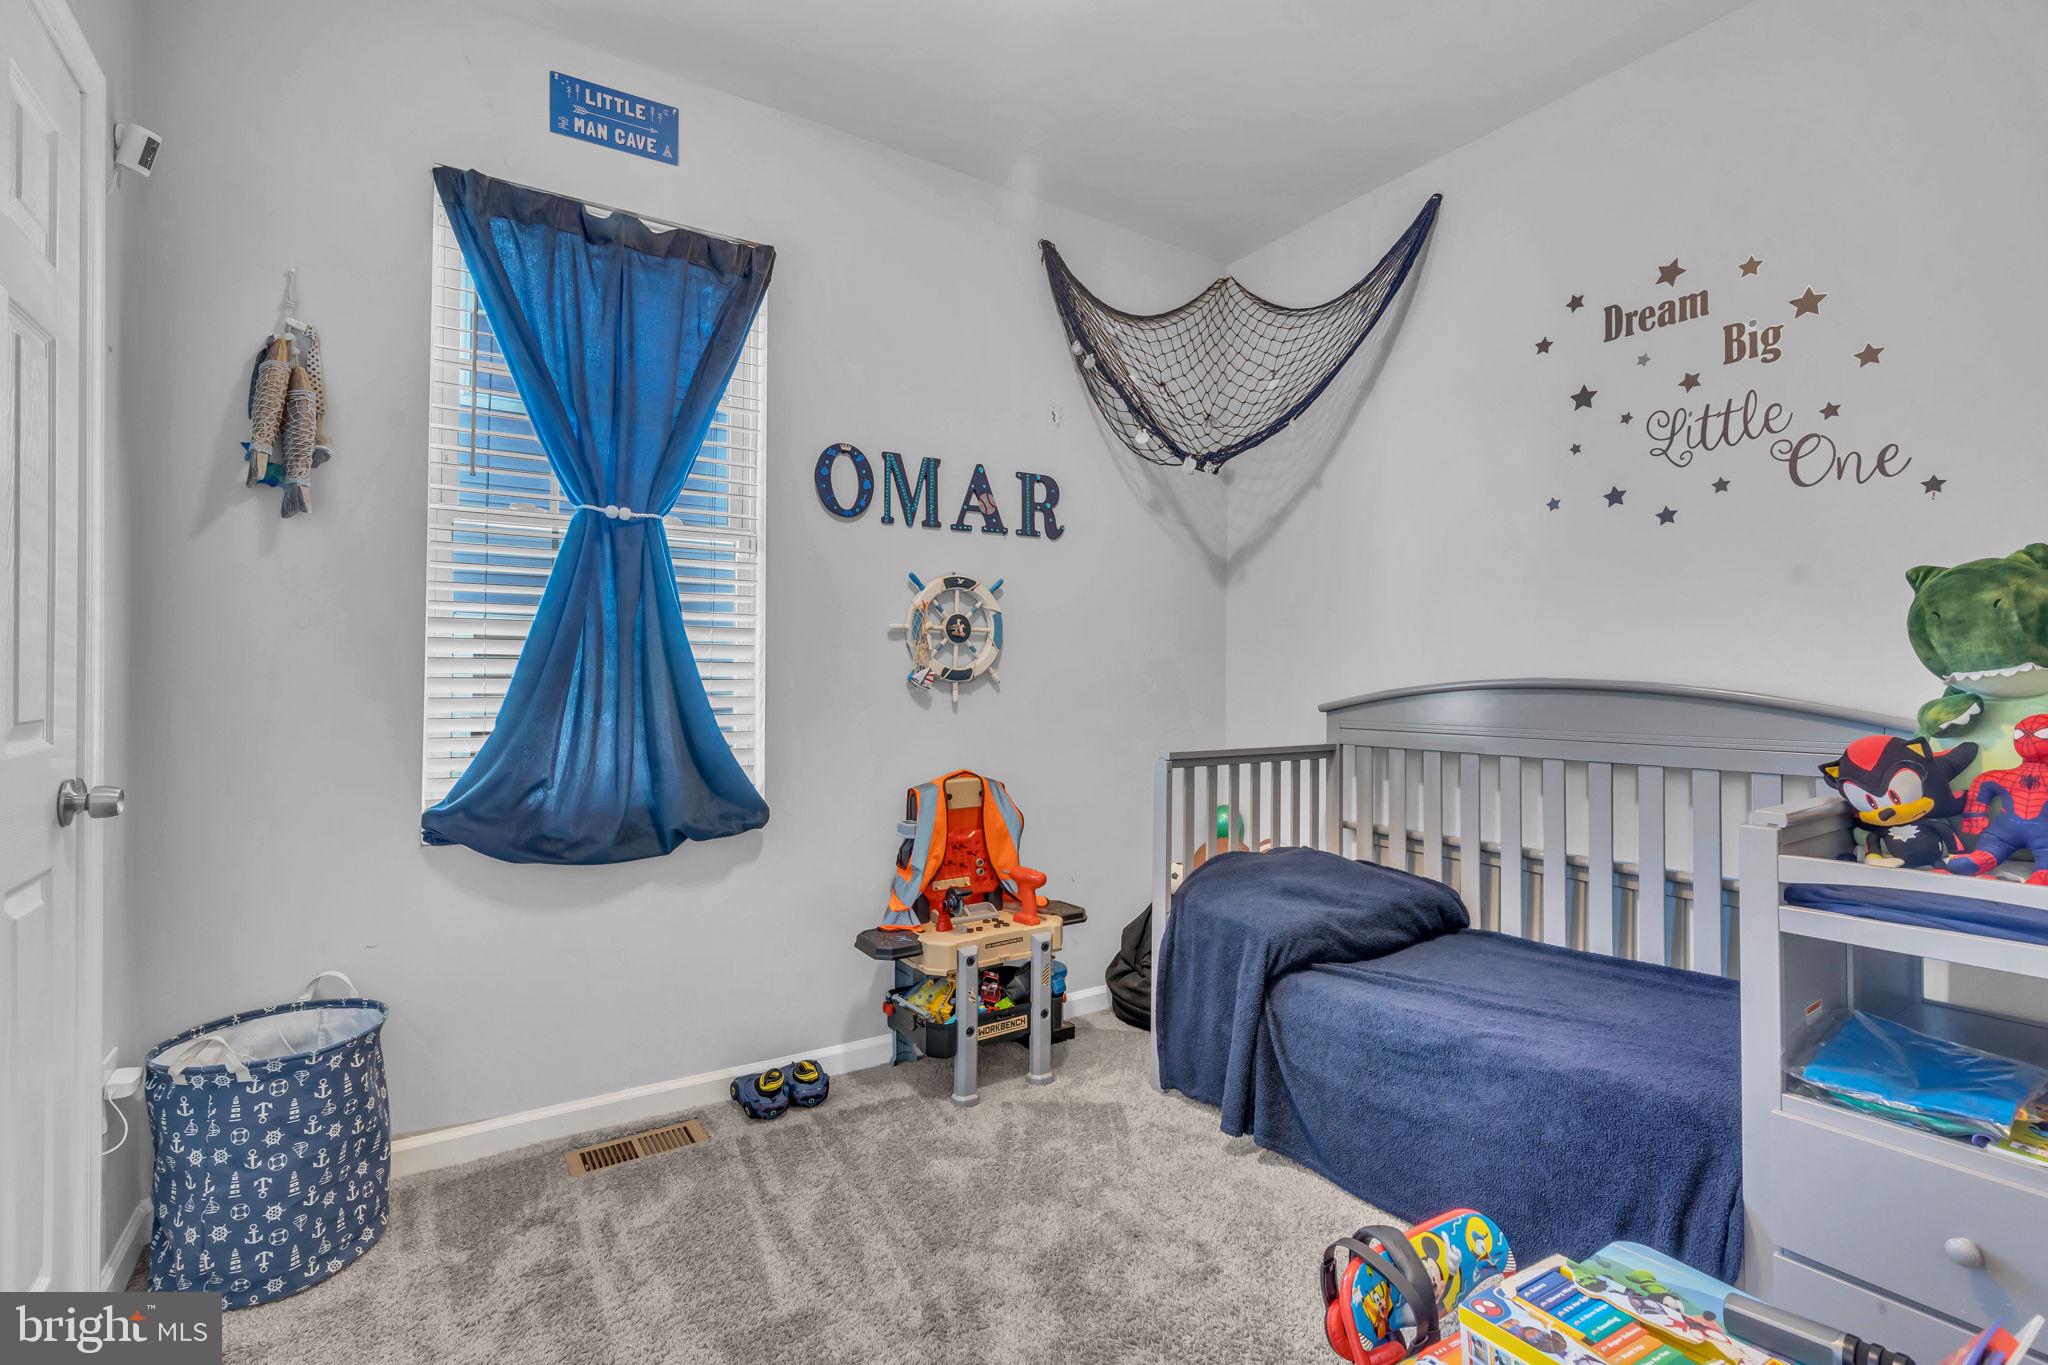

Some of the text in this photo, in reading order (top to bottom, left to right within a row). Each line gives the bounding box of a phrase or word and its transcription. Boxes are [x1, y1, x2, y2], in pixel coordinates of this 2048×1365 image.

[585, 88, 646, 120] LITTLE
[573, 117, 657, 153] MAN CAVE
[1603, 289, 1710, 342] Dream
[1722, 319, 1785, 365] Big
[1646, 389, 1793, 468] Little
[1770, 433, 1912, 488] One
[814, 442, 1065, 540] OMAR
[978, 1017, 1026, 1036] WORKBENCH
